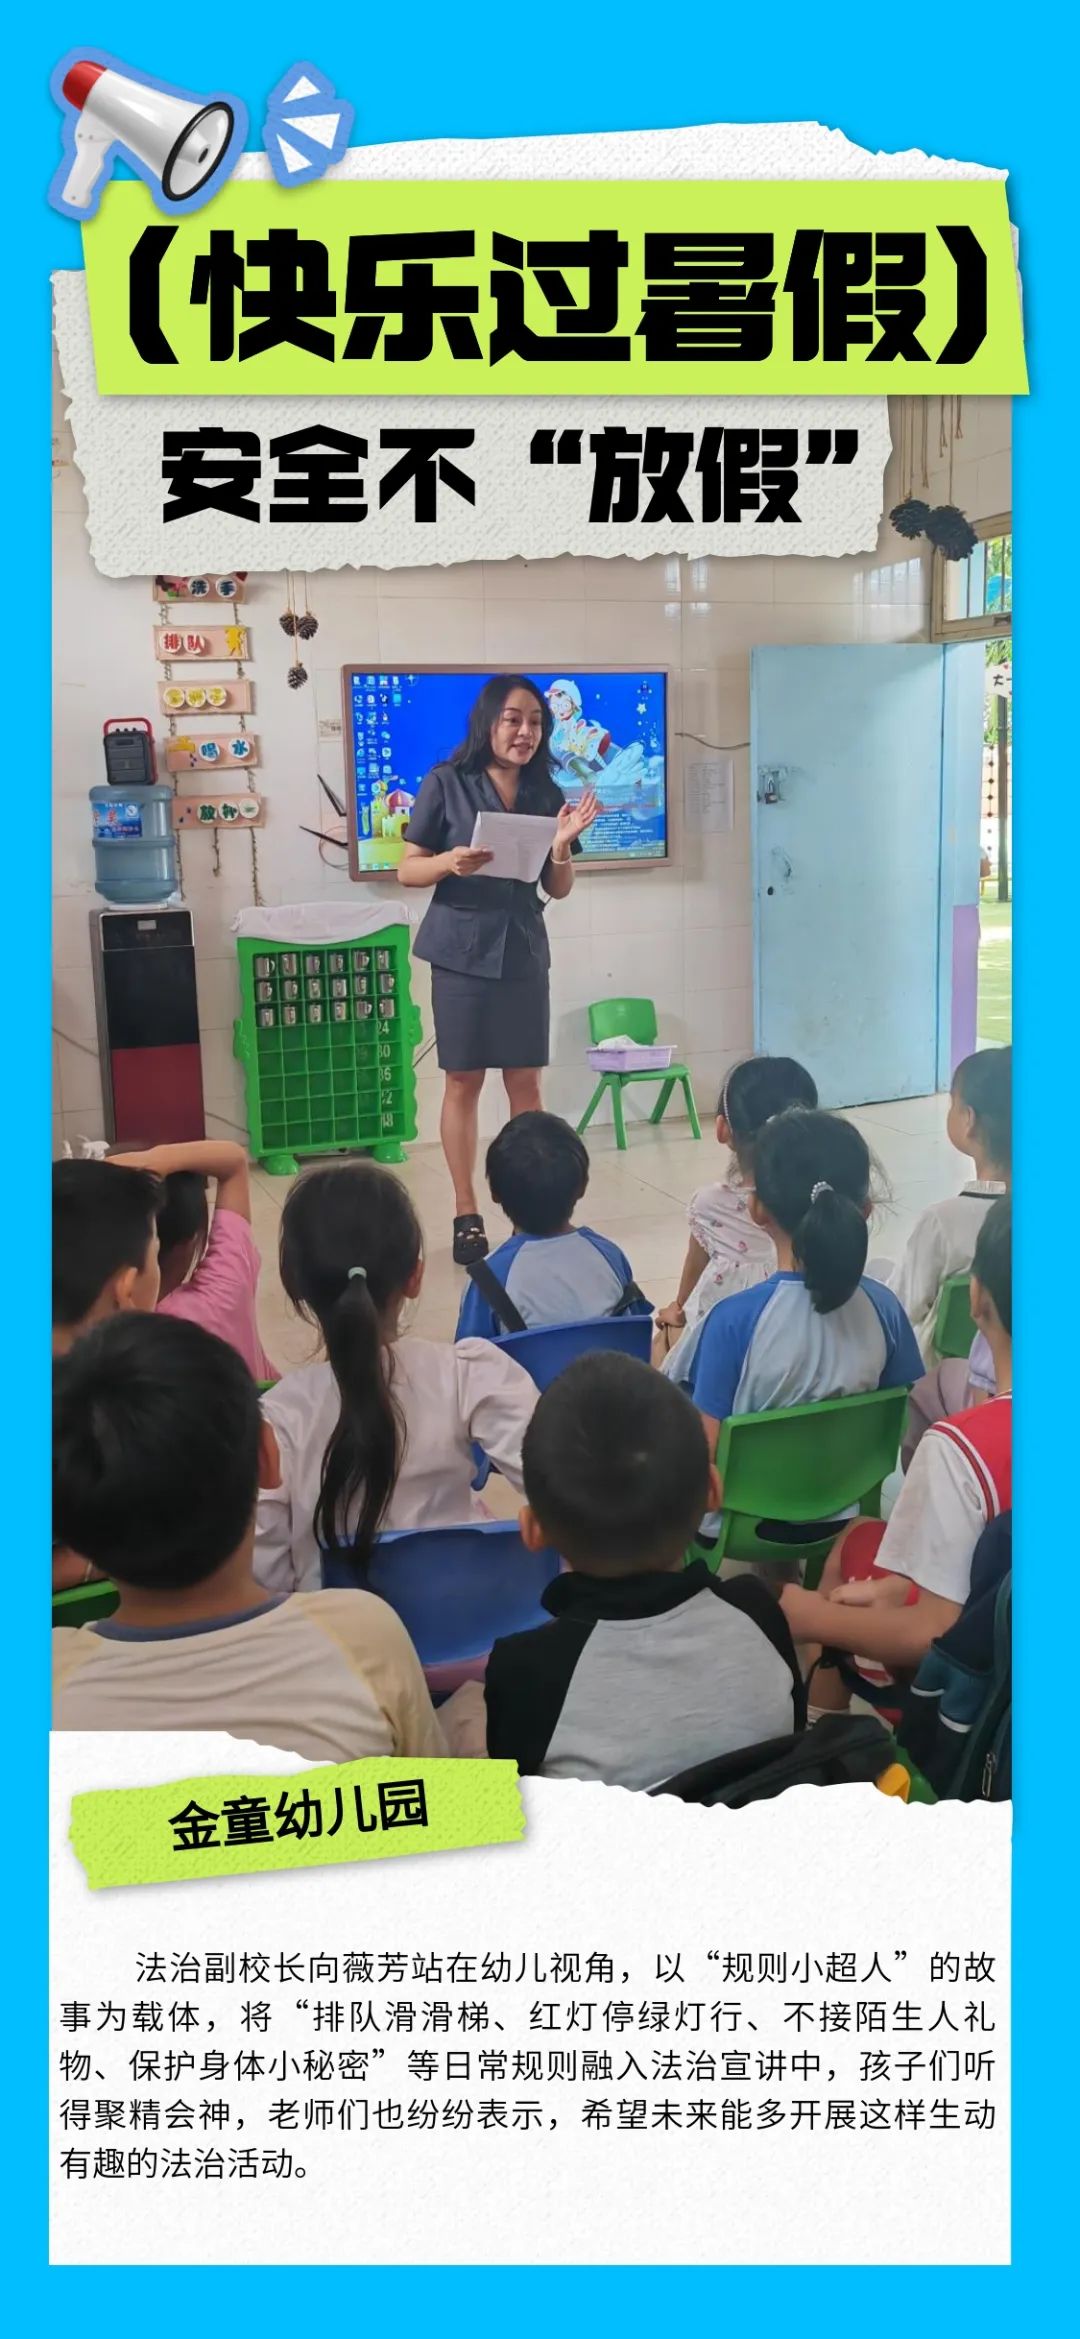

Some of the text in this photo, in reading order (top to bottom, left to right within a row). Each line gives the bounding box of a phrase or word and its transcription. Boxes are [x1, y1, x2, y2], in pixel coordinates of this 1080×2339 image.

[191, 579, 236, 596] 洗手
[163, 633, 203, 651] 排队
[201, 739, 249, 758] 喝水
